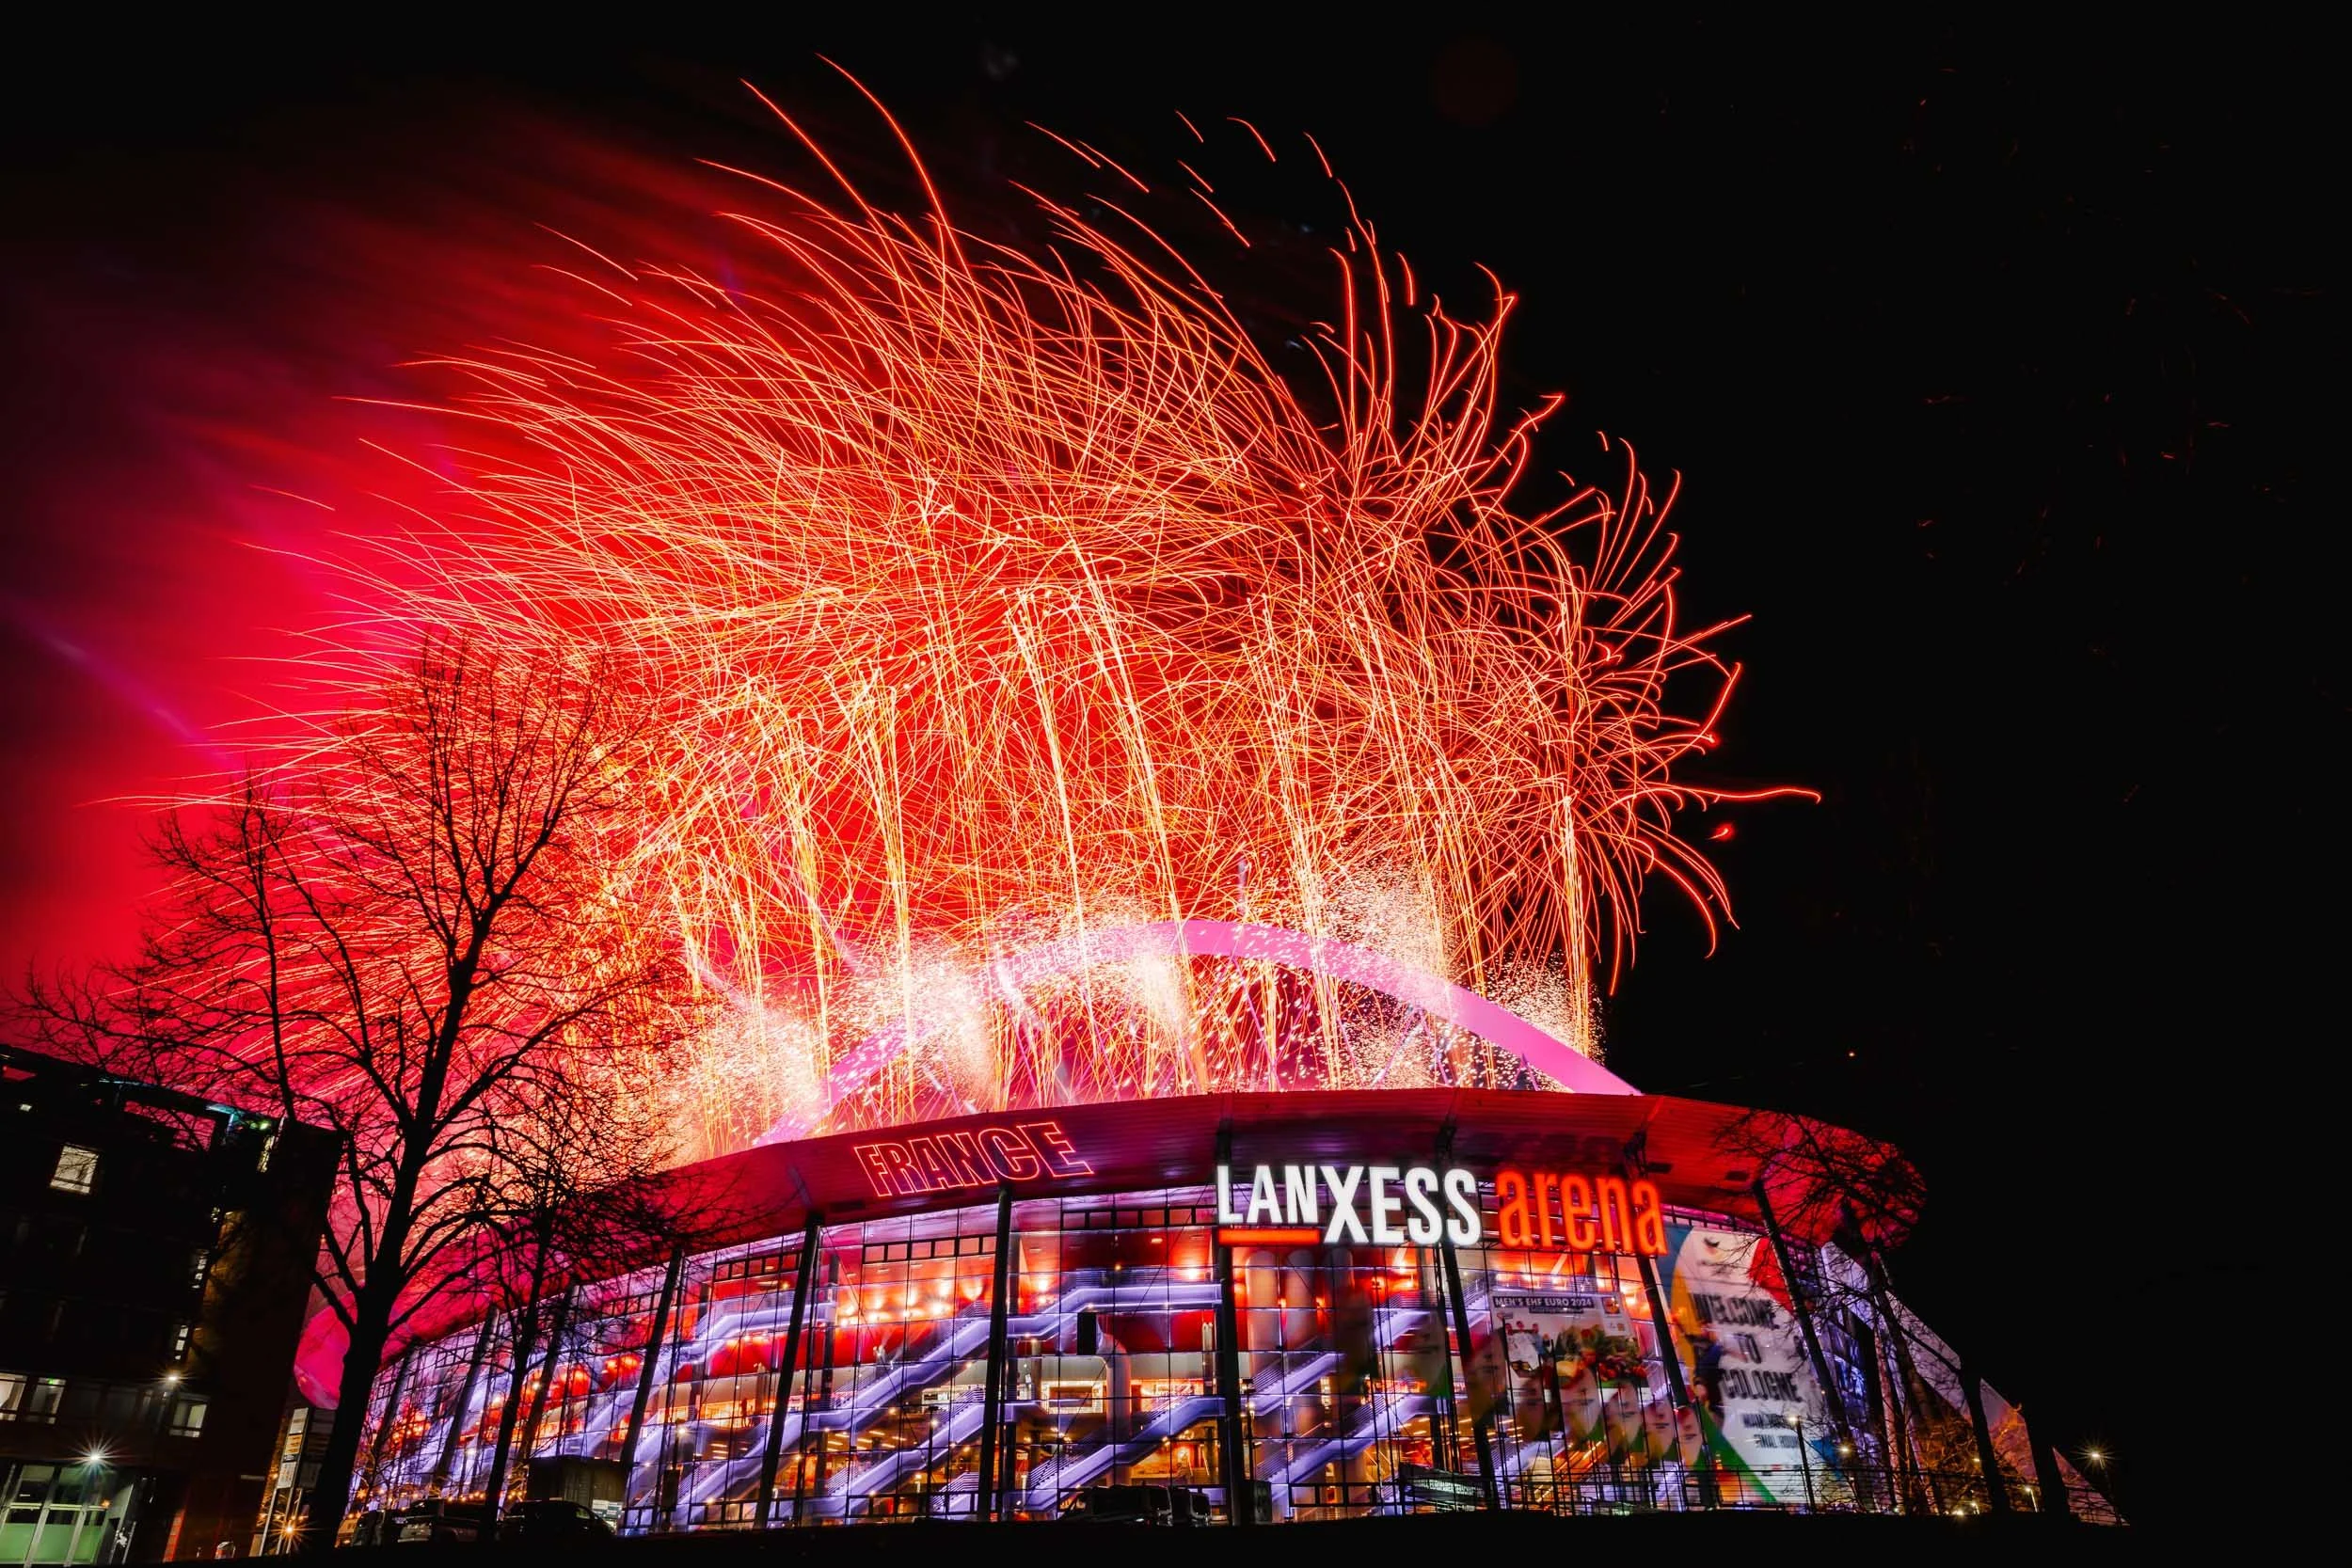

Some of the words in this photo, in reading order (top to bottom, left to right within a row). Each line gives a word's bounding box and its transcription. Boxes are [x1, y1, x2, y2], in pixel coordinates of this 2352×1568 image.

[853, 1121, 1095, 1197] FRANCE
[1216, 1164, 1482, 1247] LANXESS
[1495, 1168, 1669, 1256] arena
[1494, 1297, 1524, 1307] MEN'S
[1525, 1297, 1542, 1307] EHF
[1544, 1297, 1569, 1307] EURO
[1570, 1297, 1593, 1307] 2024
[1692, 1293, 1780, 1330] WELCOME
[1733, 1332, 1762, 1364] TO
[1719, 1368, 1804, 1402] COLOGNE
